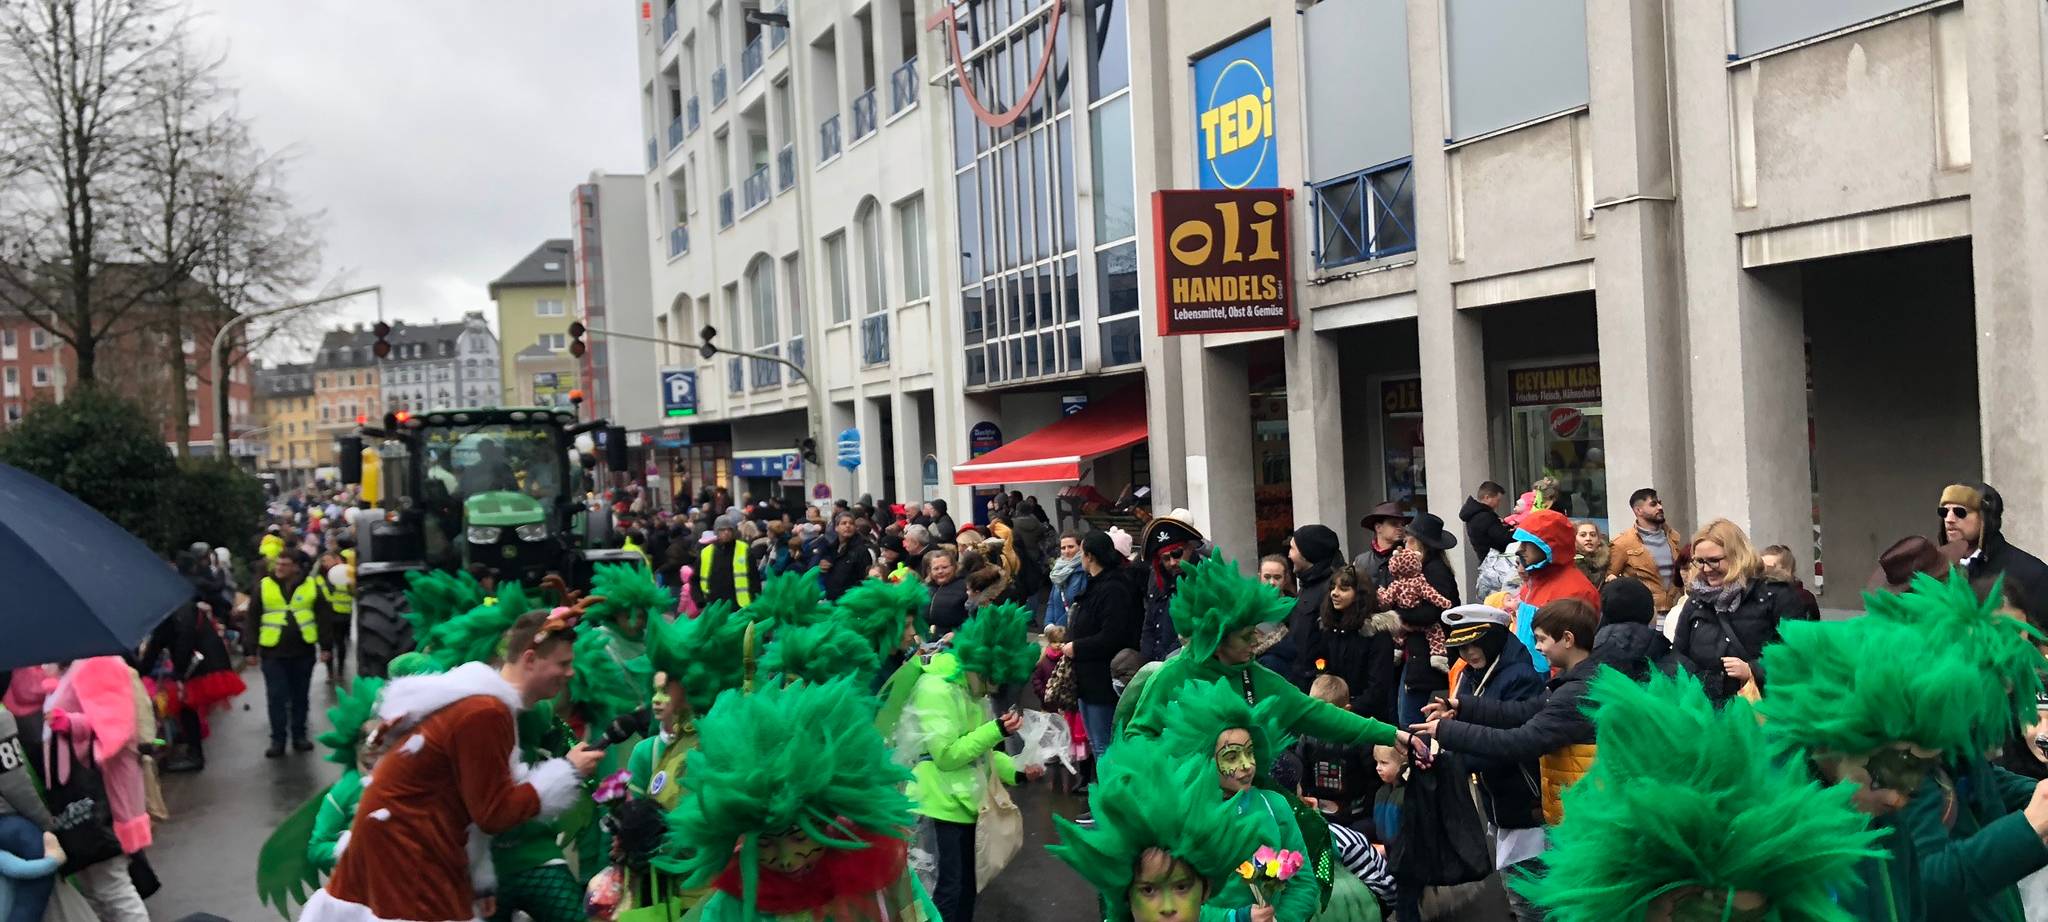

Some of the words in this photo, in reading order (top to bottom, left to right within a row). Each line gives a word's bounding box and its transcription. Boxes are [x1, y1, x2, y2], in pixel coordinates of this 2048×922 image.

[1200, 86, 1273, 160] TEDi
[1170, 200, 1280, 266] oli
[1172, 274, 1277, 304] HANDELS
[1174, 306, 1227, 320] Lebensmittel,
[1228, 305, 1246, 318] Obst
[1247, 305, 1253, 317] &
[1254, 304, 1284, 317] Gemüse
[672, 380, 689, 403] P
[1516, 369, 1565, 392] CEYLAN
